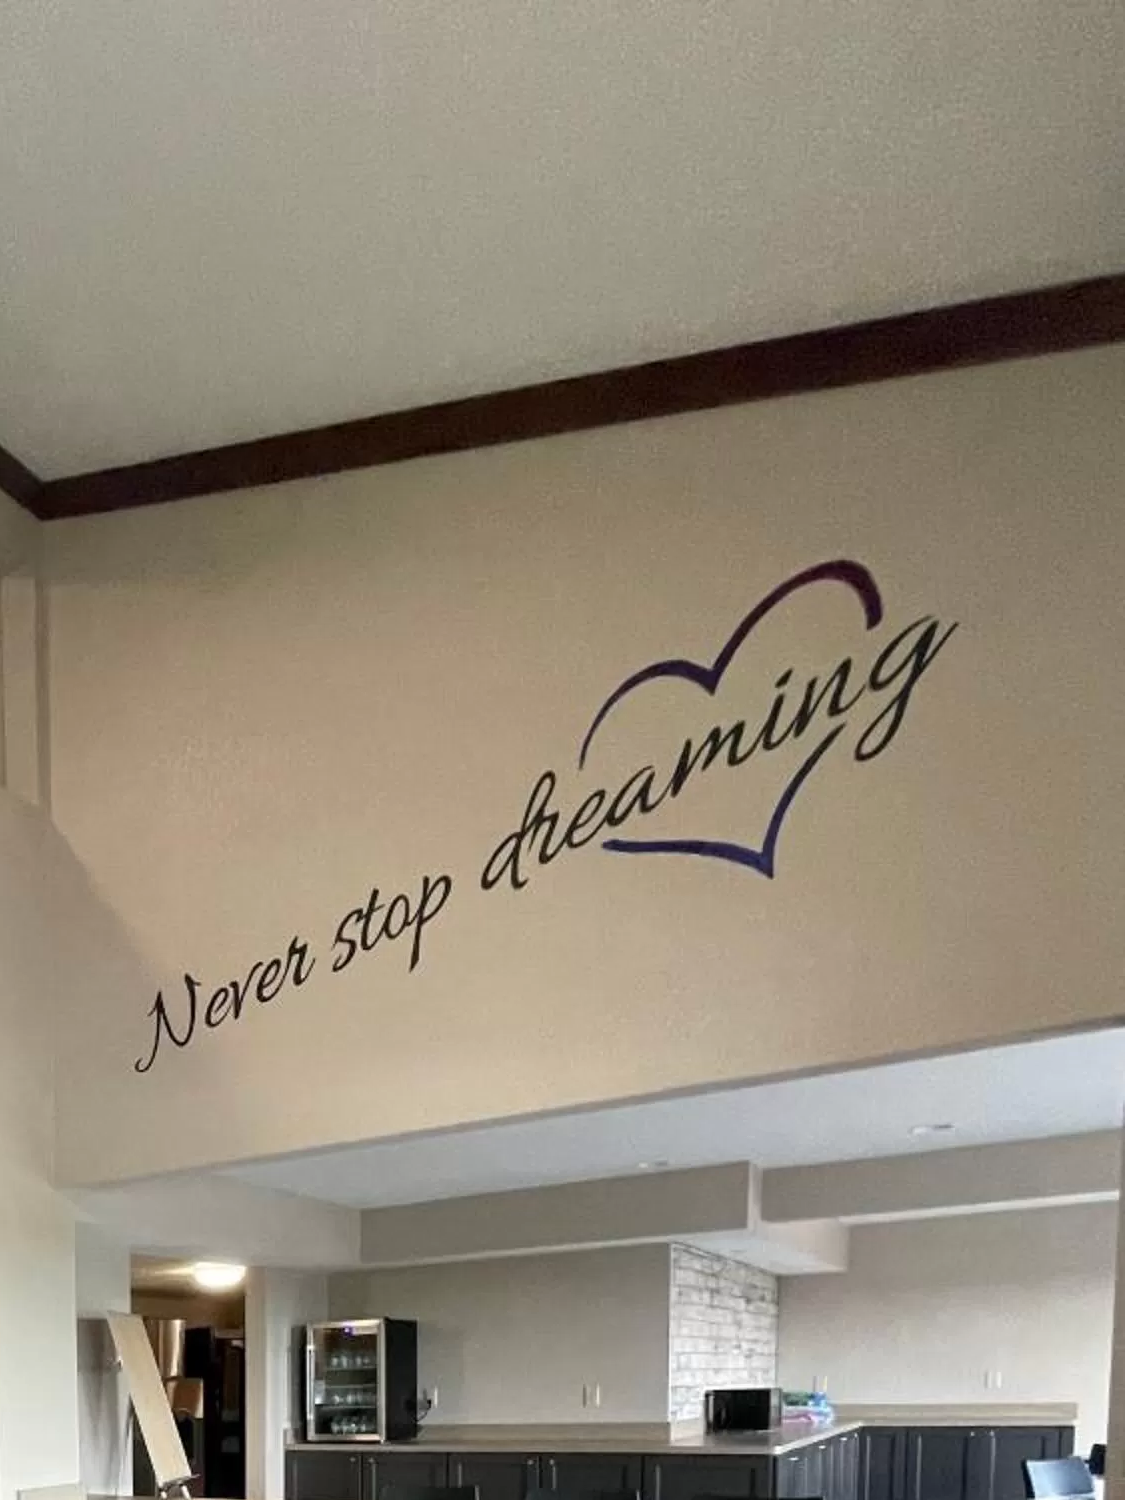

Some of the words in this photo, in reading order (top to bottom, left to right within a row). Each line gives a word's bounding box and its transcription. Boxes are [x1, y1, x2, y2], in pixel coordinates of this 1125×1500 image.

[135, 935, 314, 1074] Never
[331, 872, 453, 972] stop
[480, 614, 959, 891] dreaming
